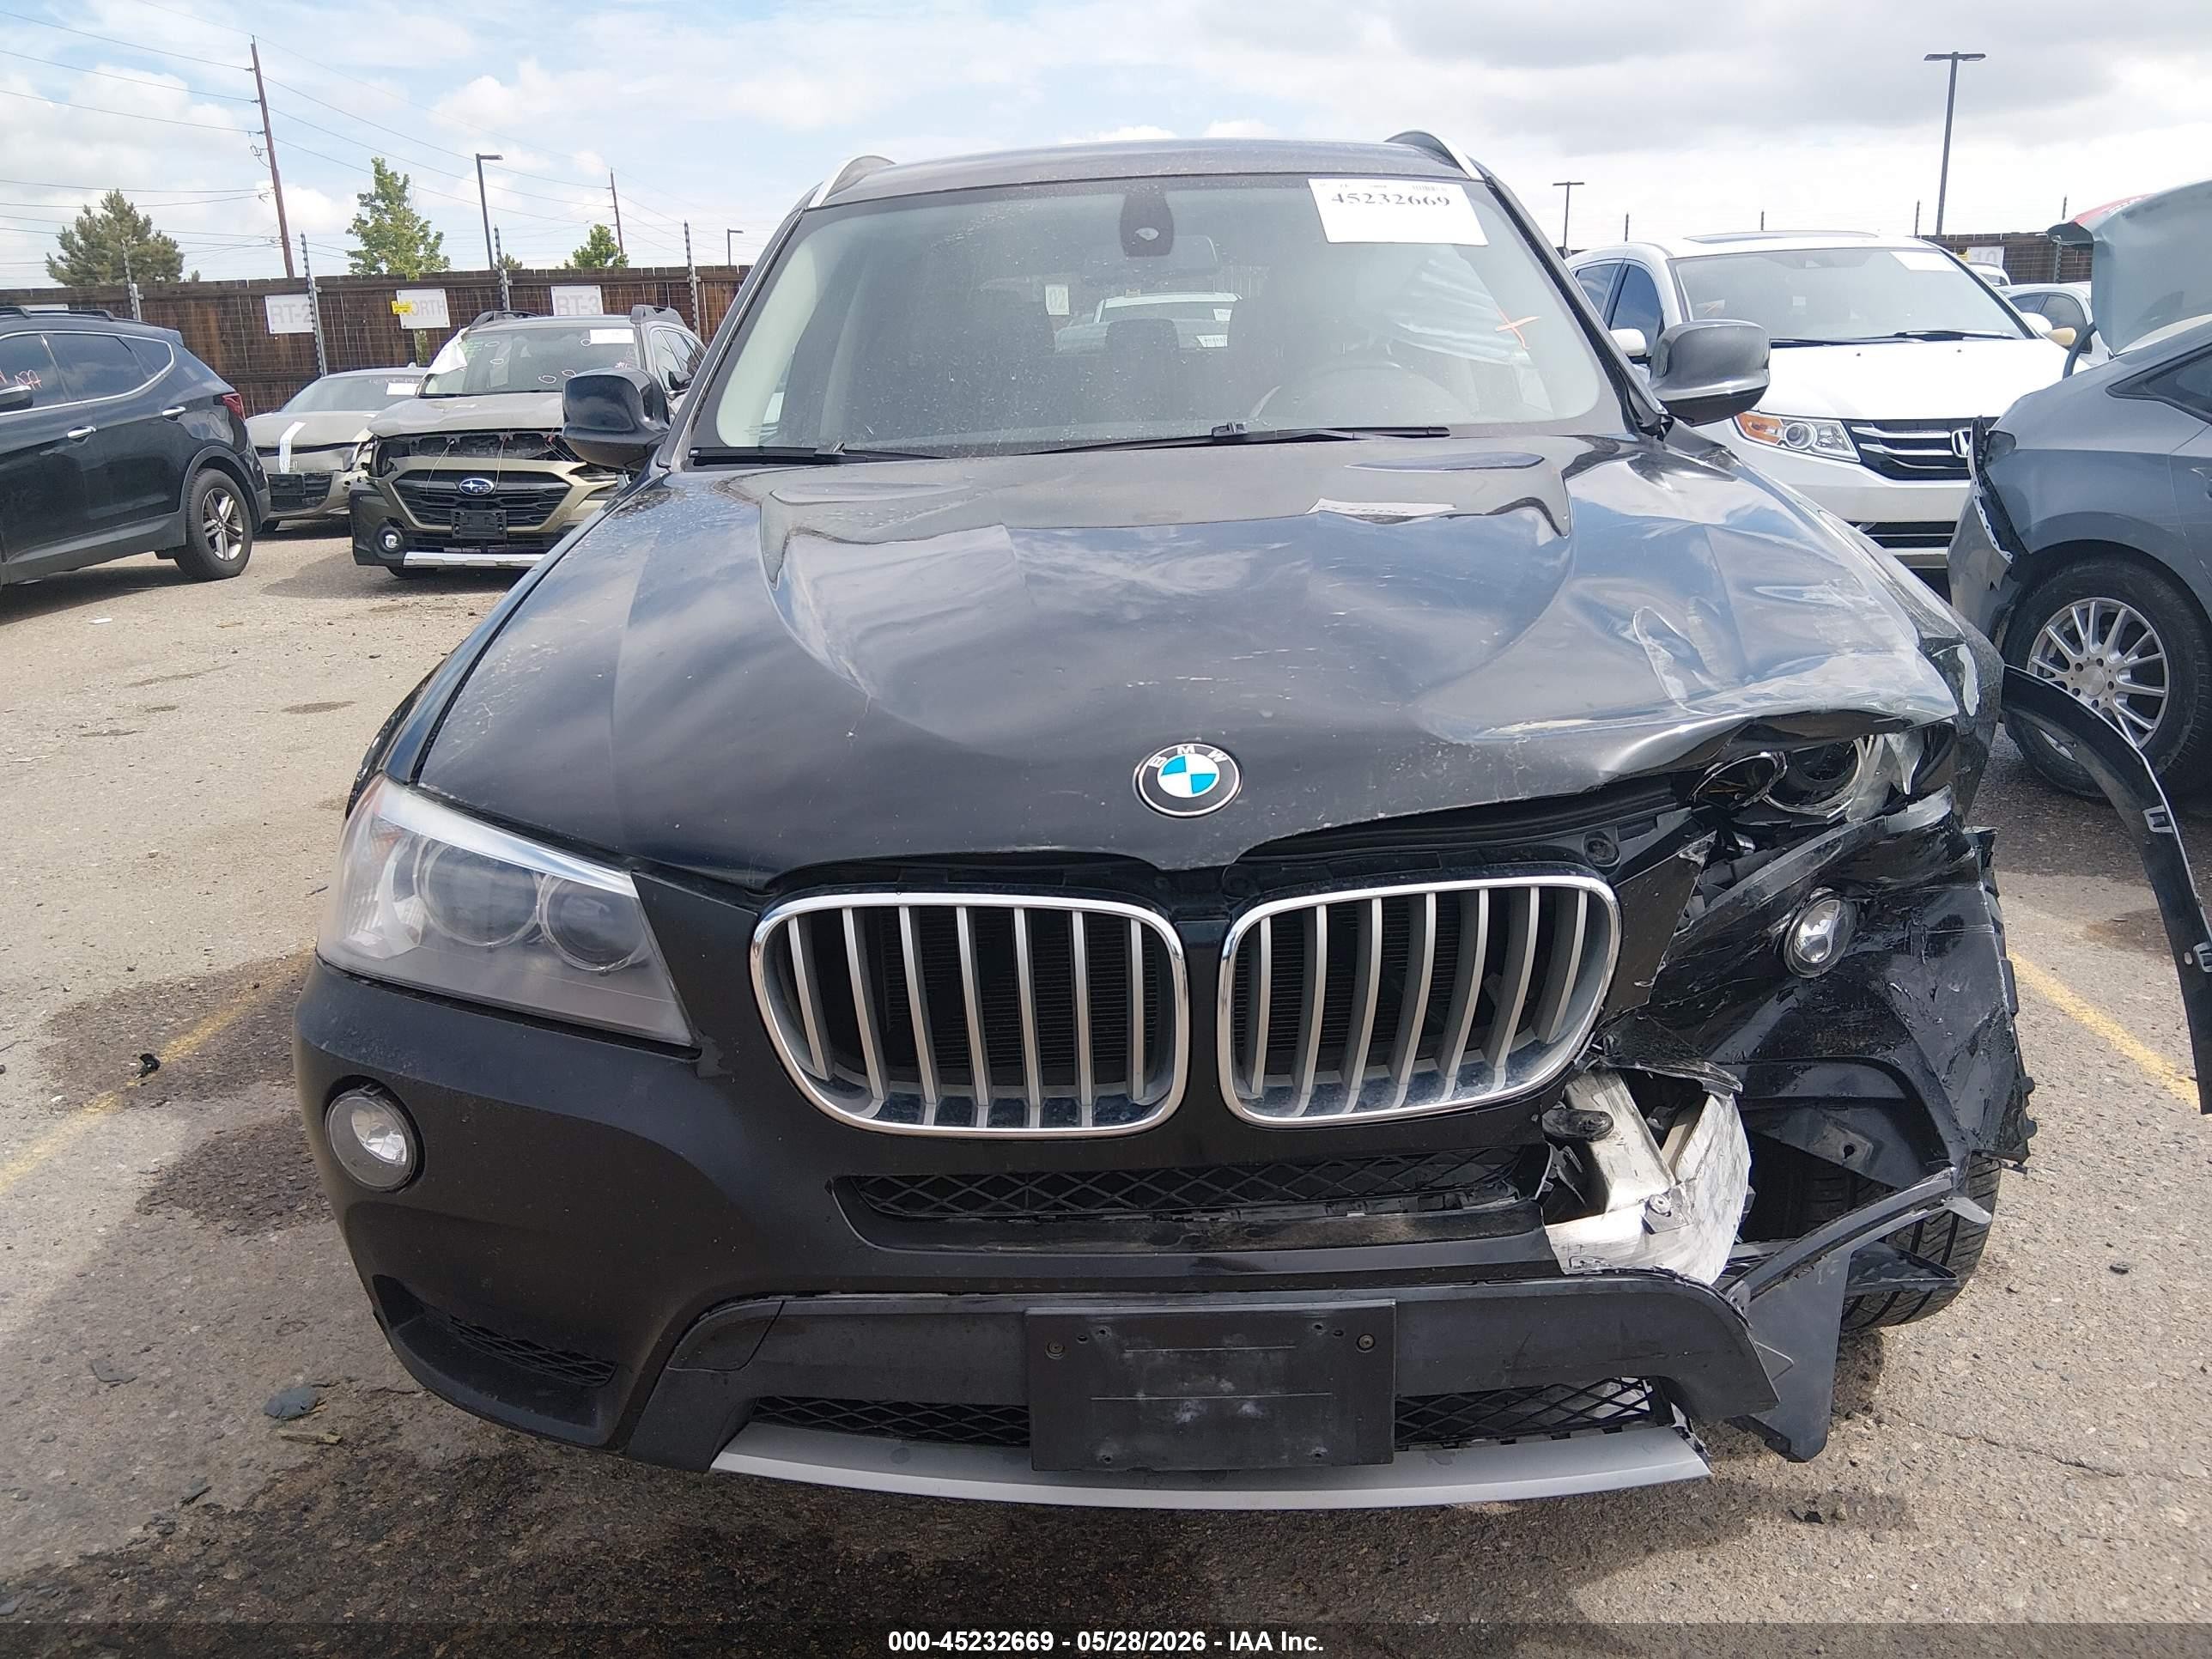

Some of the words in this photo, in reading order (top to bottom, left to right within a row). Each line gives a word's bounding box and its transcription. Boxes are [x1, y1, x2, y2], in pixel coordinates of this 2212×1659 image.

[1331, 192, 1451, 206] 45232669
[270, 303, 312, 323] RT-2
[555, 295, 600, 315] RT-3
[1147, 744, 1229, 769] BMW
